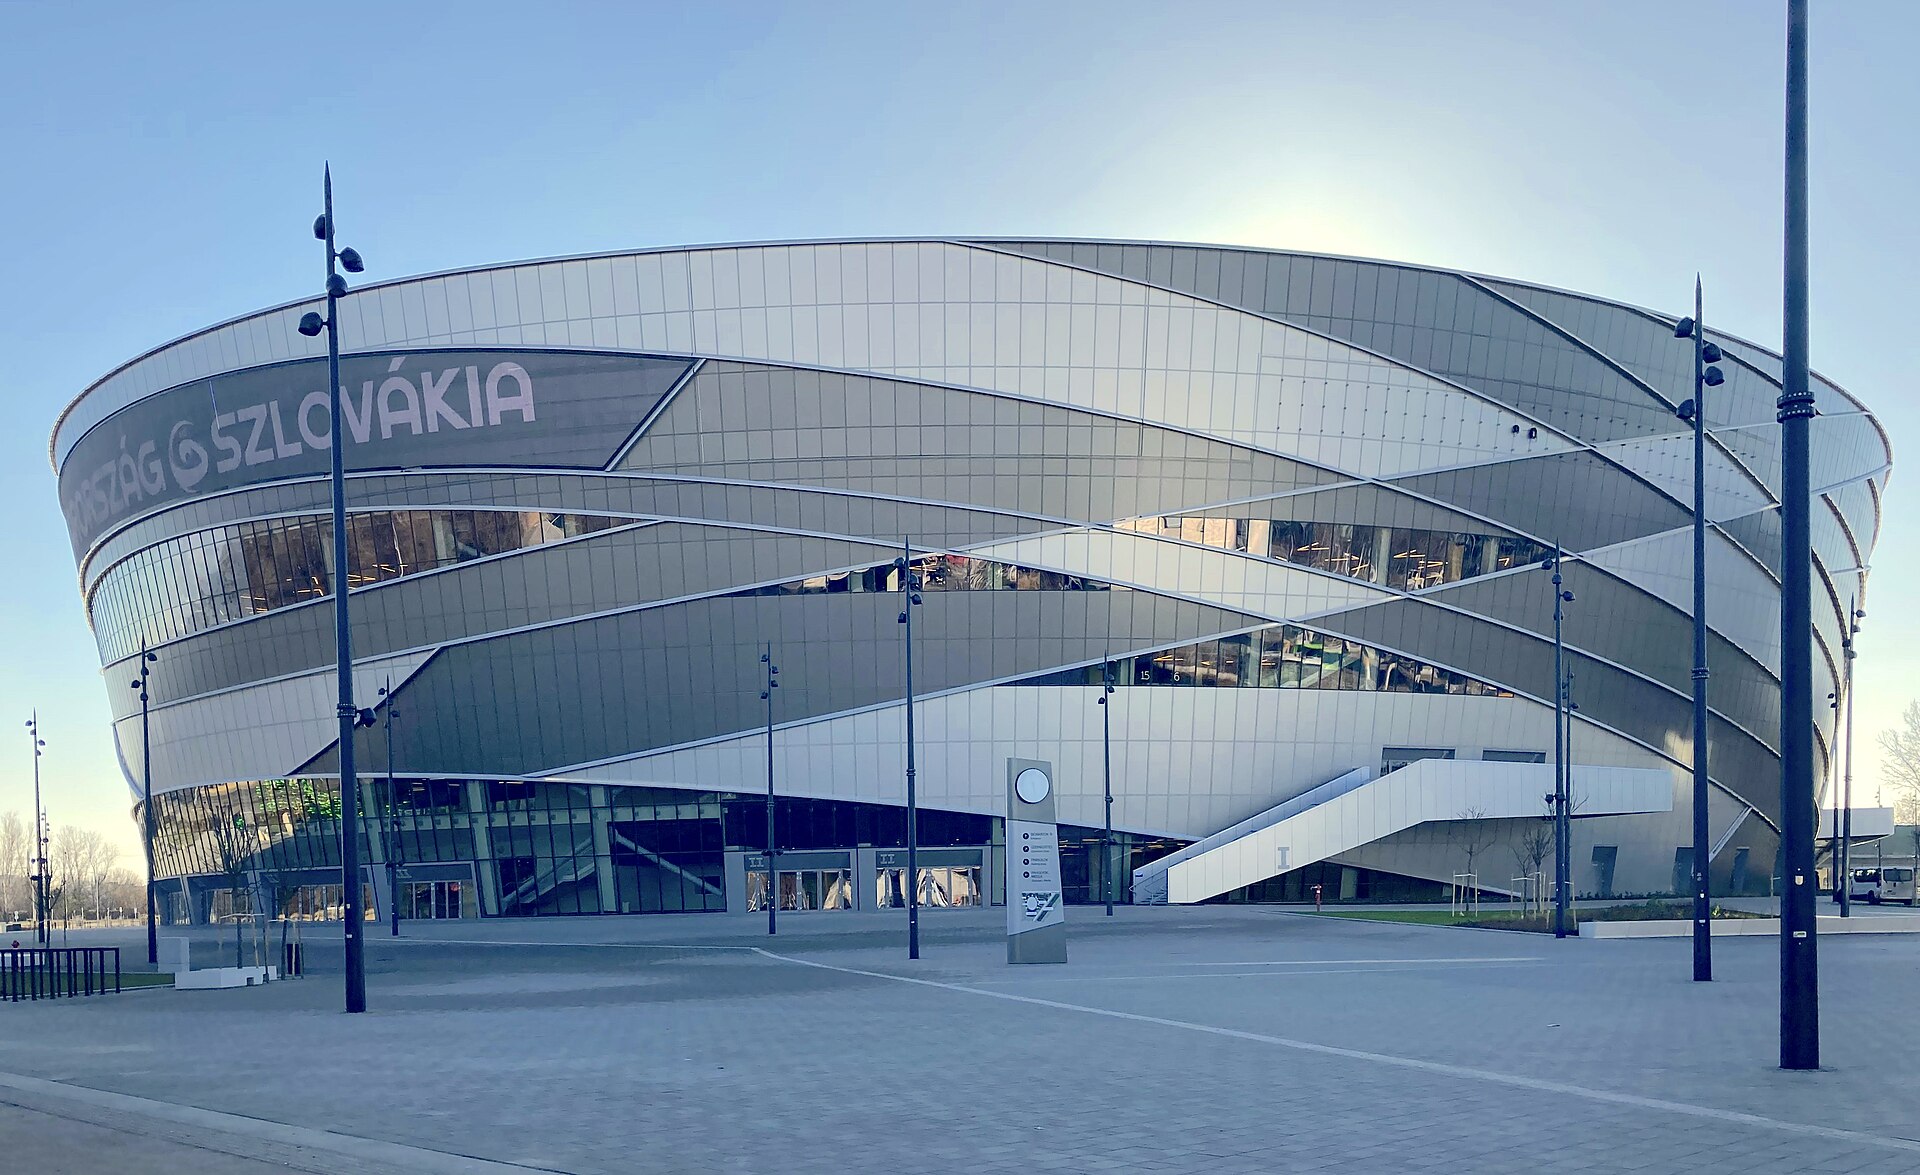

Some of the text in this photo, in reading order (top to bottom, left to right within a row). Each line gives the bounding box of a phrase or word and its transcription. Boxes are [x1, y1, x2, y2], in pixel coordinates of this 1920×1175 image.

[210, 357, 536, 474] SZLOVÁKIA
[1140, 670, 1151, 681] 15
[1277, 846, 1290, 870] I
